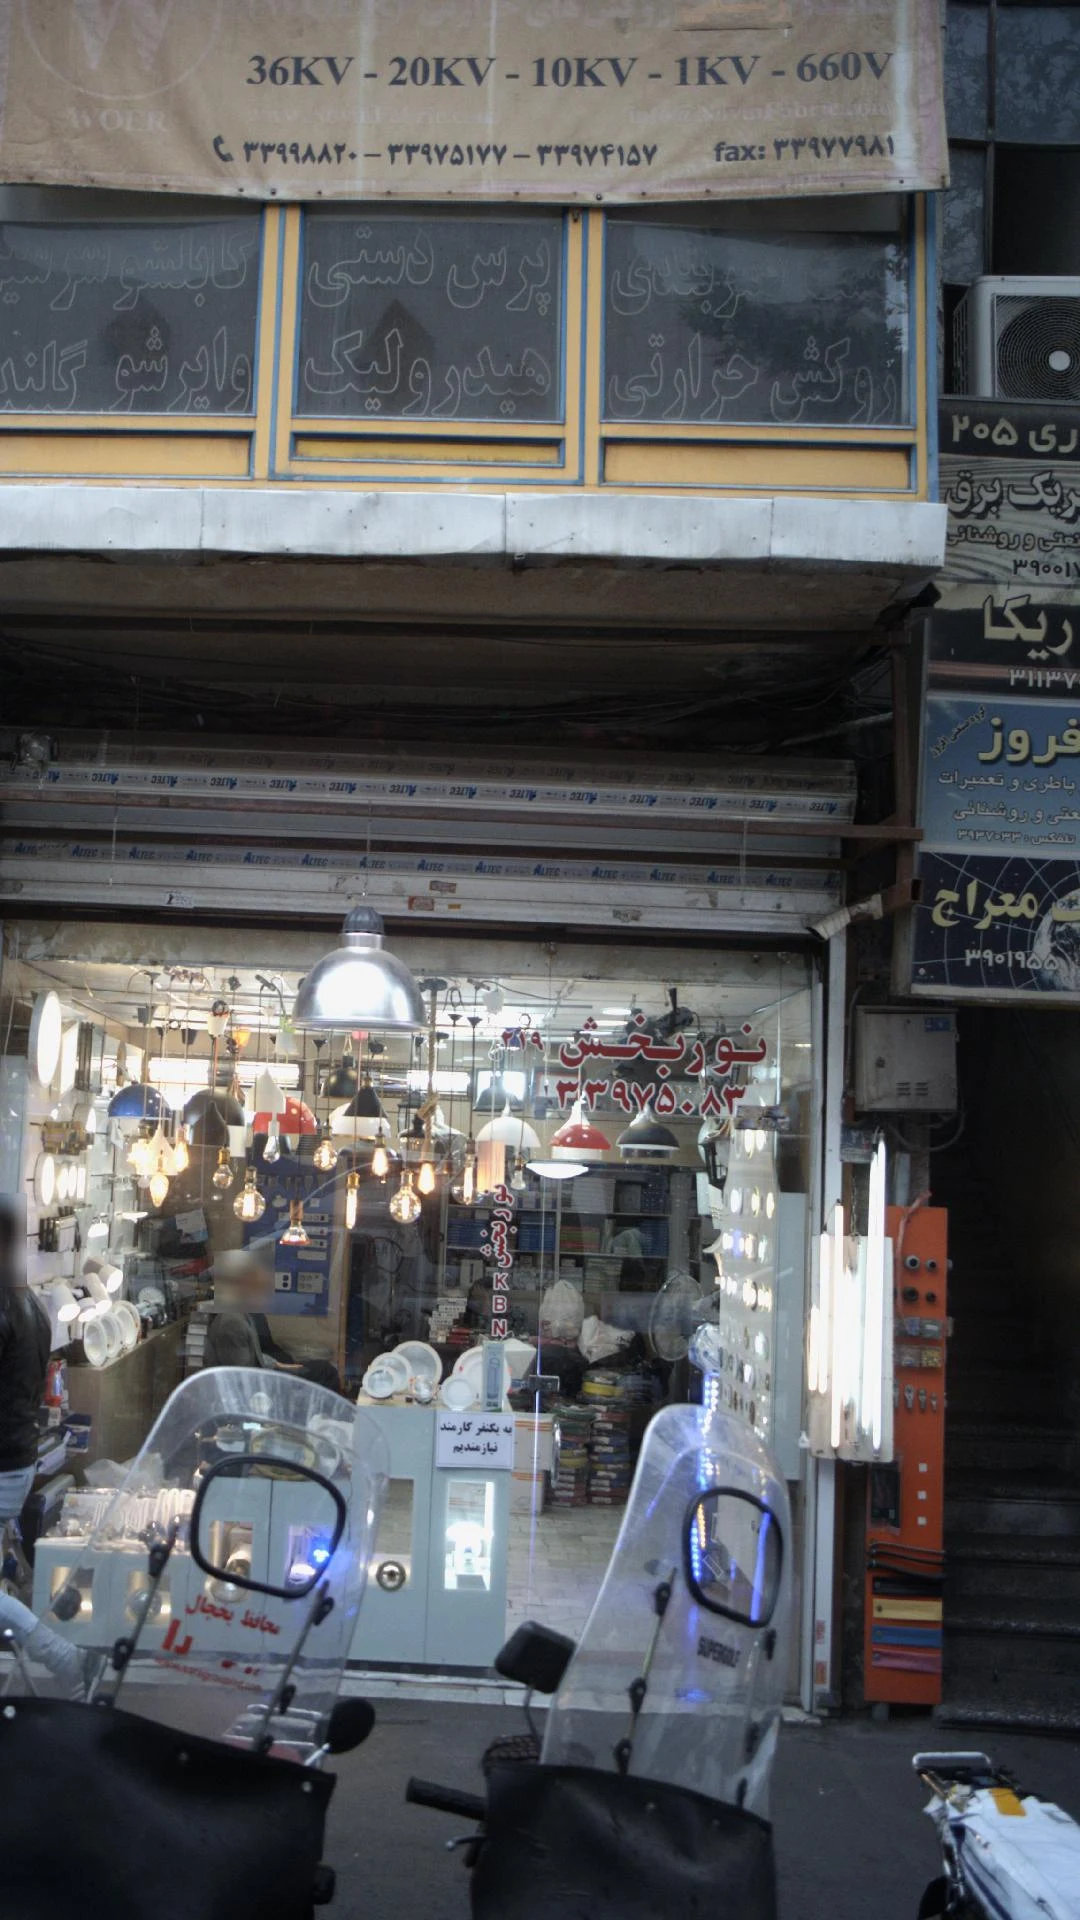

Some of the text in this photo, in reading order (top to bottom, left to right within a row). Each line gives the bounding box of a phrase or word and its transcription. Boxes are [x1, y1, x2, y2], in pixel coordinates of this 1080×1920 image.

[246, 55, 354, 86] 36KV
[388, 56, 496, 86] 20KV
[532, 57, 638, 87] 10KV
[675, 55, 761, 86] 1KV
[796, 51, 894, 82] 660V
[388, 142, 507, 166] ۳۳۹۷۵۱۷۷
[537, 144, 657, 166] ۳۳۹۷۴۱۵۷
[714, 141, 766, 162] fax:
[448, 239, 550, 316] پرس
[952, 414, 1019, 446] ۲۰۵
[945, 470, 1003, 517] برق
[1009, 668, 1080, 690] ۳۱۱۳۷
[360, 856, 385, 869] ATEC
[931, 880, 1039, 930] معراج
[965, 948, 1060, 970] ۳۹۰۱۹۵۵
[559, 1013, 768, 1077] نوربخش
[555, 1079, 748, 1117] ۳۳۹۷۵۰۸۳
[440, 1421, 473, 1436] کارمند
[453, 1441, 498, 1455] نیازمندیم
